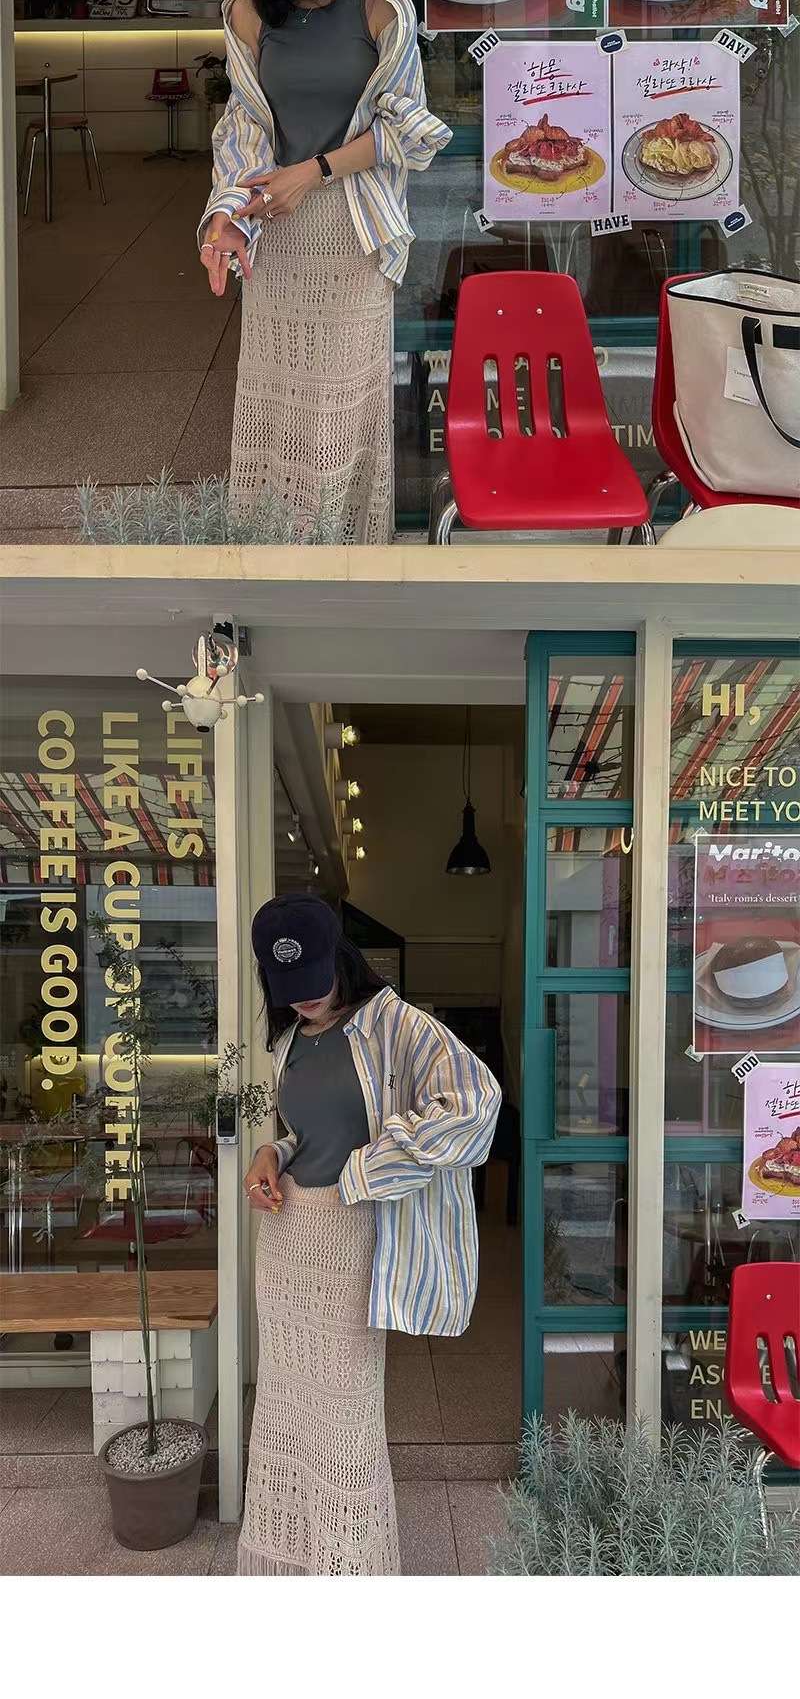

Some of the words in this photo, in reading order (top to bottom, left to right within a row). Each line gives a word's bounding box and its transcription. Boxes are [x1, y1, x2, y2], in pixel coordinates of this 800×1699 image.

[717, 33, 751, 59] DAY!
[479, 214, 491, 227] A
[593, 214, 631, 232] HAVE
[612, 425, 657, 447] TIM
[702, 683, 761, 726] HI,
[103, 712, 140, 809] LIKE
[700, 766, 756, 787] NICE
[761, 766, 797, 787] TO
[38, 710, 76, 879] COFFEE
[699, 801, 765, 821] MEET
[104, 820, 140, 850] A
[168, 818, 204, 859] IS
[40, 893, 77, 933] IS
[104, 861, 141, 951] CUP
[41, 945, 78, 1091] GOOD.
[738, 1213, 747, 1224] A
